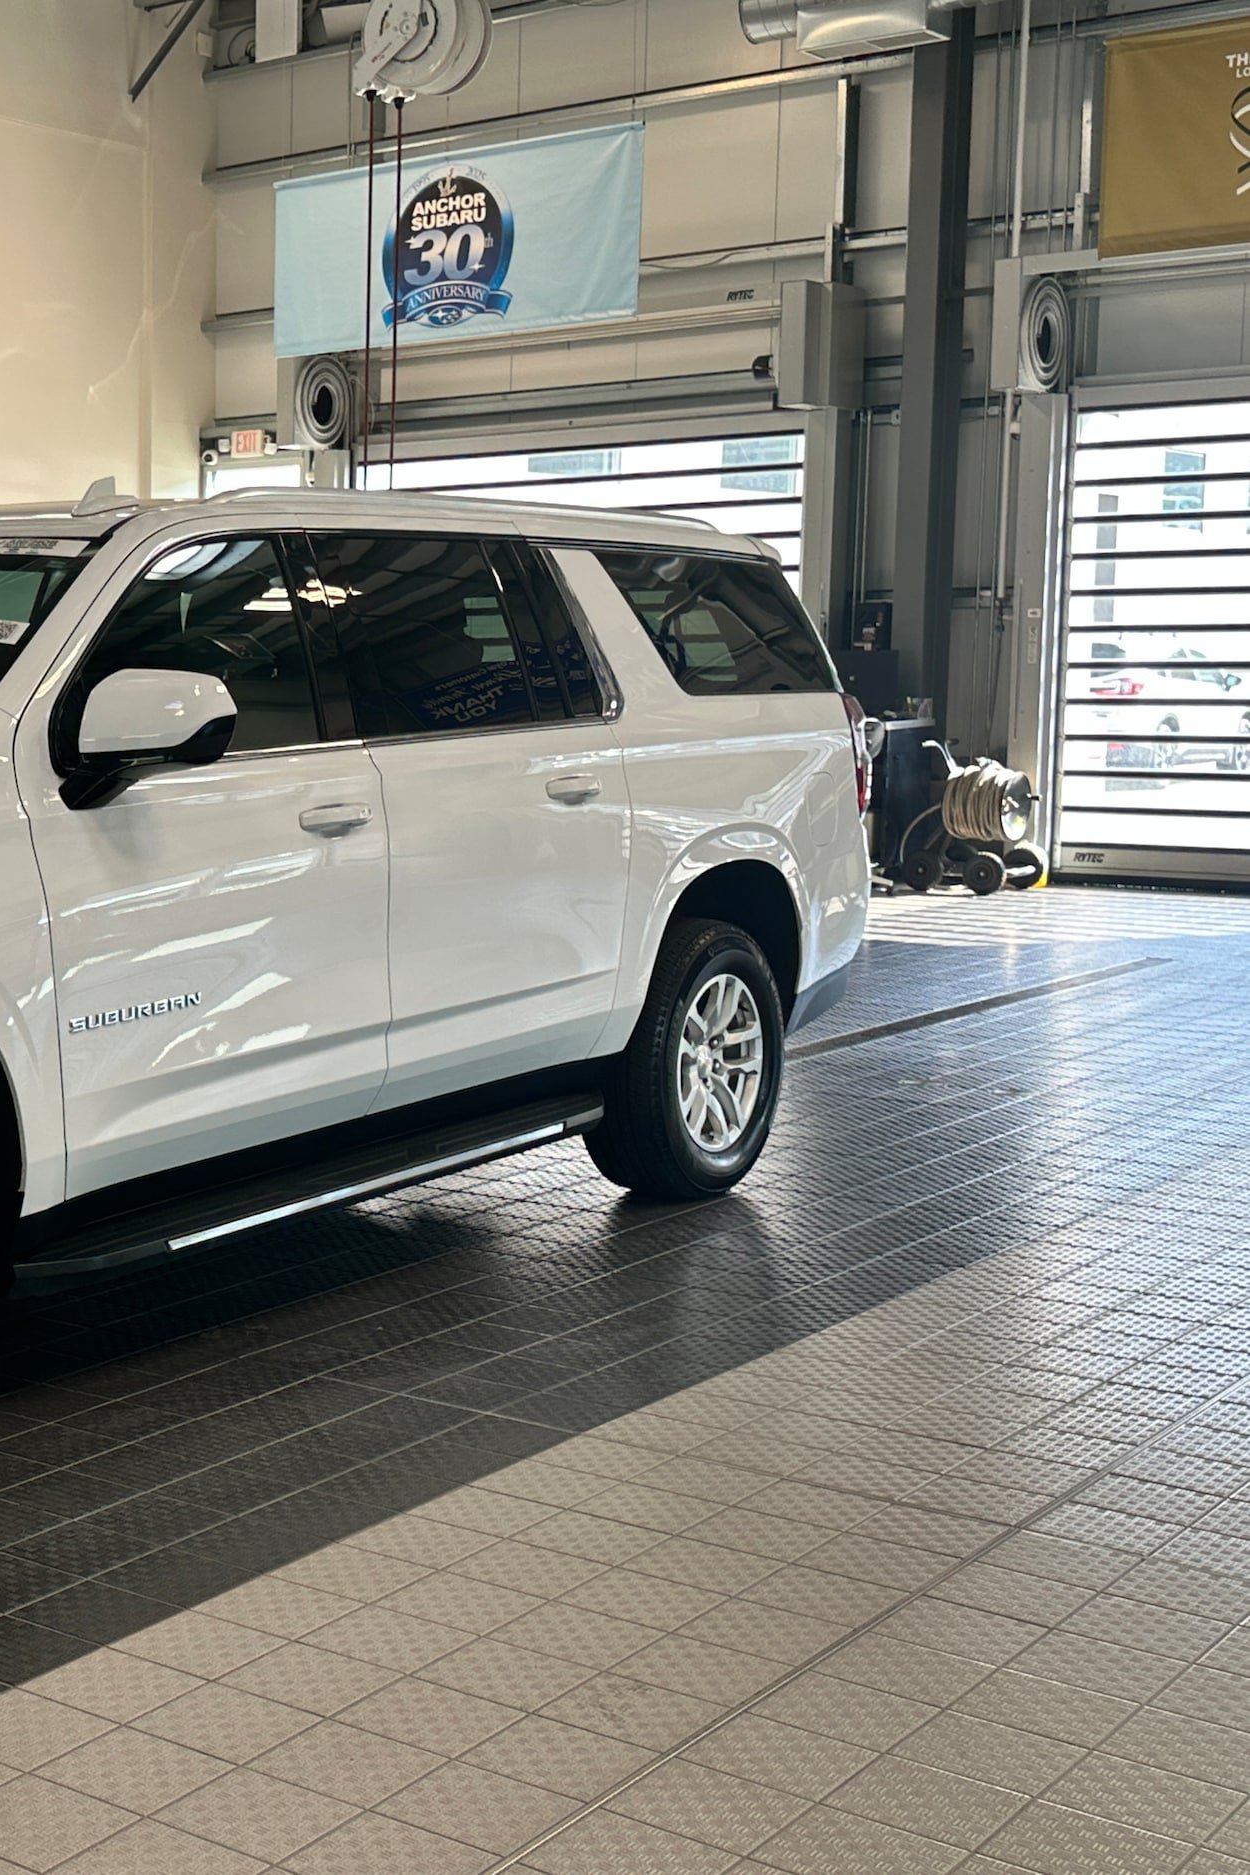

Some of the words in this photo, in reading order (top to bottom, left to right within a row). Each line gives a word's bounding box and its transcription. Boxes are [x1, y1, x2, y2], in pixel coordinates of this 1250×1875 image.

[1225, 52, 1250, 68] TH
[412, 192, 486, 217] ANCHOR
[411, 207, 486, 231] SUBARU
[406, 284, 487, 312] ANNIVERSARY
[726, 289, 755, 302] RYTEC
[236, 432, 258, 453] EXIT
[1074, 852, 1105, 863] RYTEC
[69, 991, 202, 1033] SUBURBAN
